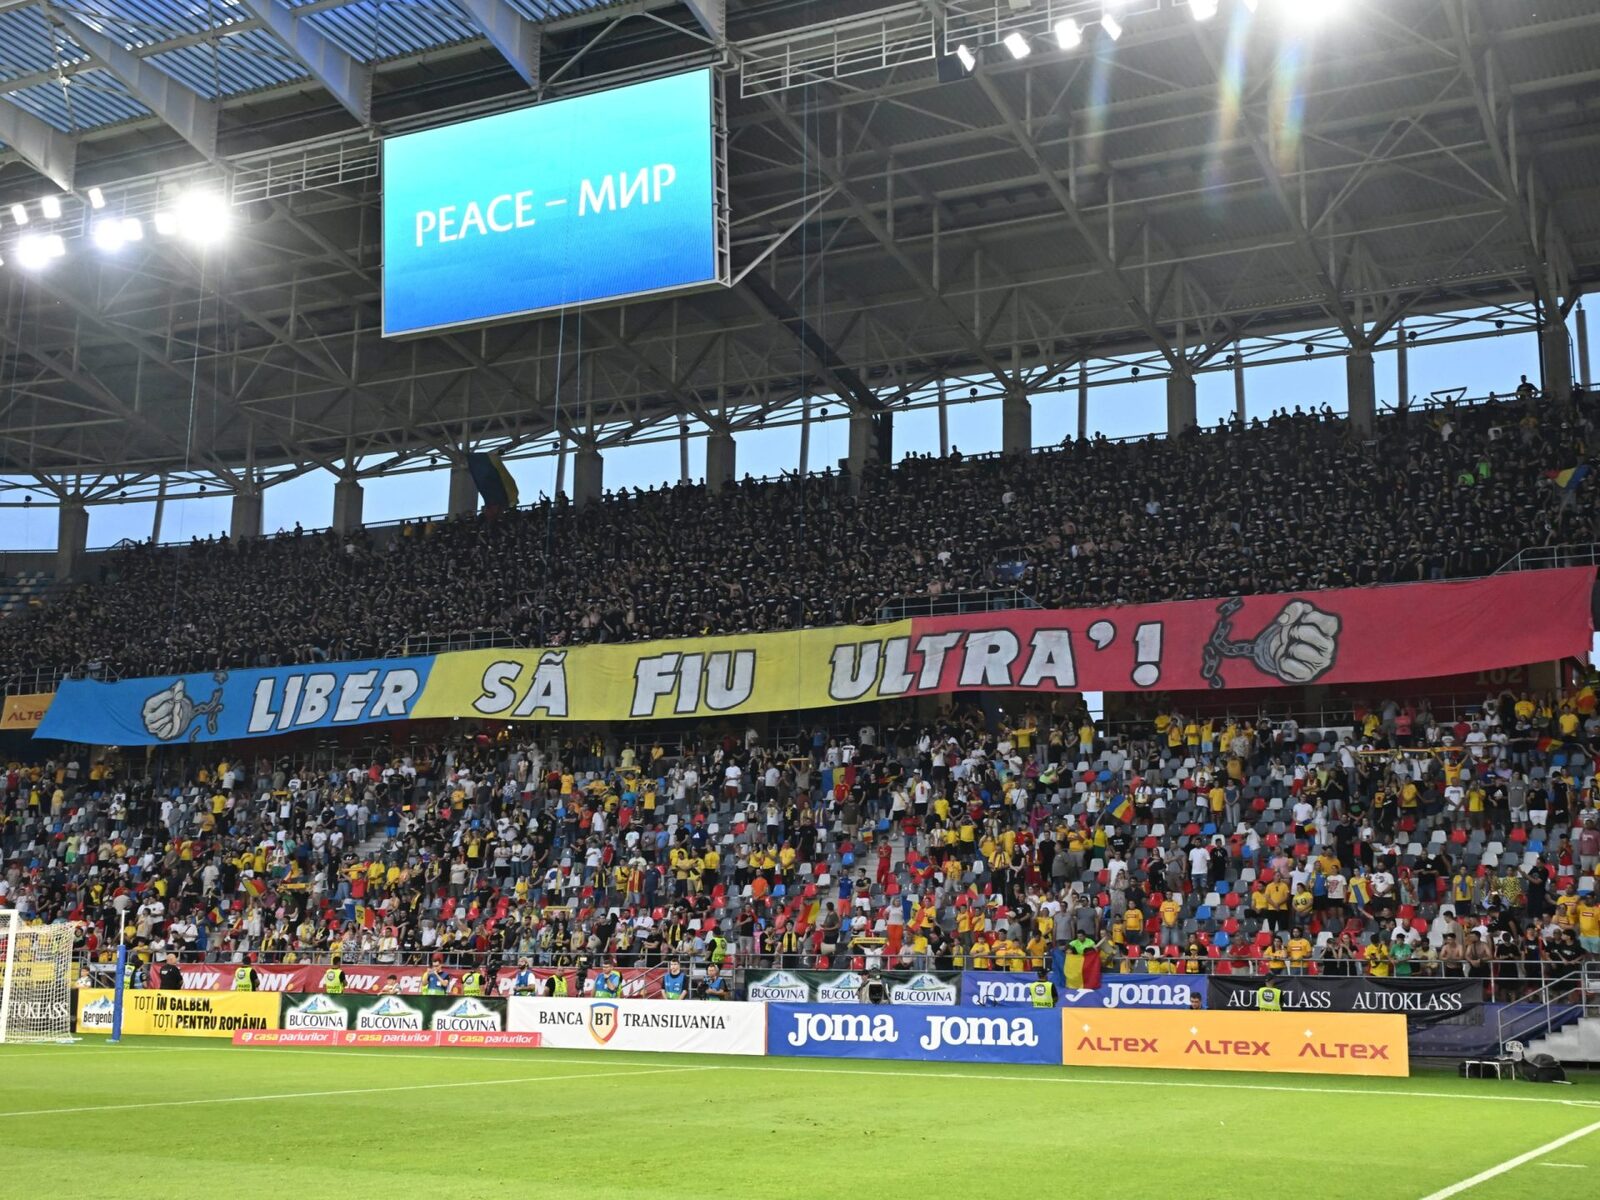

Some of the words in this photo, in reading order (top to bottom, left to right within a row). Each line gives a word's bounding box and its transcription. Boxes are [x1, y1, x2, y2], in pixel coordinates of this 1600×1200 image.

[415, 190, 535, 247] PEACE
[578, 163, 676, 216] МИР
[248, 668, 419, 733] LIBER
[629, 649, 756, 717] FIU
[8, 710, 47, 721] ALTE
[751, 987, 805, 1000] BUCOVINA
[821, 989, 859, 999] BUCOV
[894, 990, 952, 1001] BUCOVINA
[156, 994, 167, 1010] ÎN
[169, 997, 213, 1013] GALBEN,
[1352, 992, 1462, 1010] AUTOKLASS
[83, 1010, 114, 1025] Bergenb
[175, 1014, 217, 1029] PENTRU
[219, 1013, 267, 1030] ROMÂNIA
[289, 1015, 344, 1027] BUCOVINA
[361, 1016, 418, 1029] BUCOVINA
[539, 1011, 583, 1025] BANCA
[594, 1012, 612, 1026] BT
[623, 1013, 725, 1029] TRANSILVANIA
[437, 1018, 496, 1031] BUCOVINA
[253, 1032, 279, 1041] casa
[280, 1030, 329, 1042] pariurilor
[357, 1033, 383, 1041] casa
[382, 1032, 432, 1043] pariurilor
[460, 1034, 484, 1042] casa
[485, 1033, 533, 1044] pariurilor
